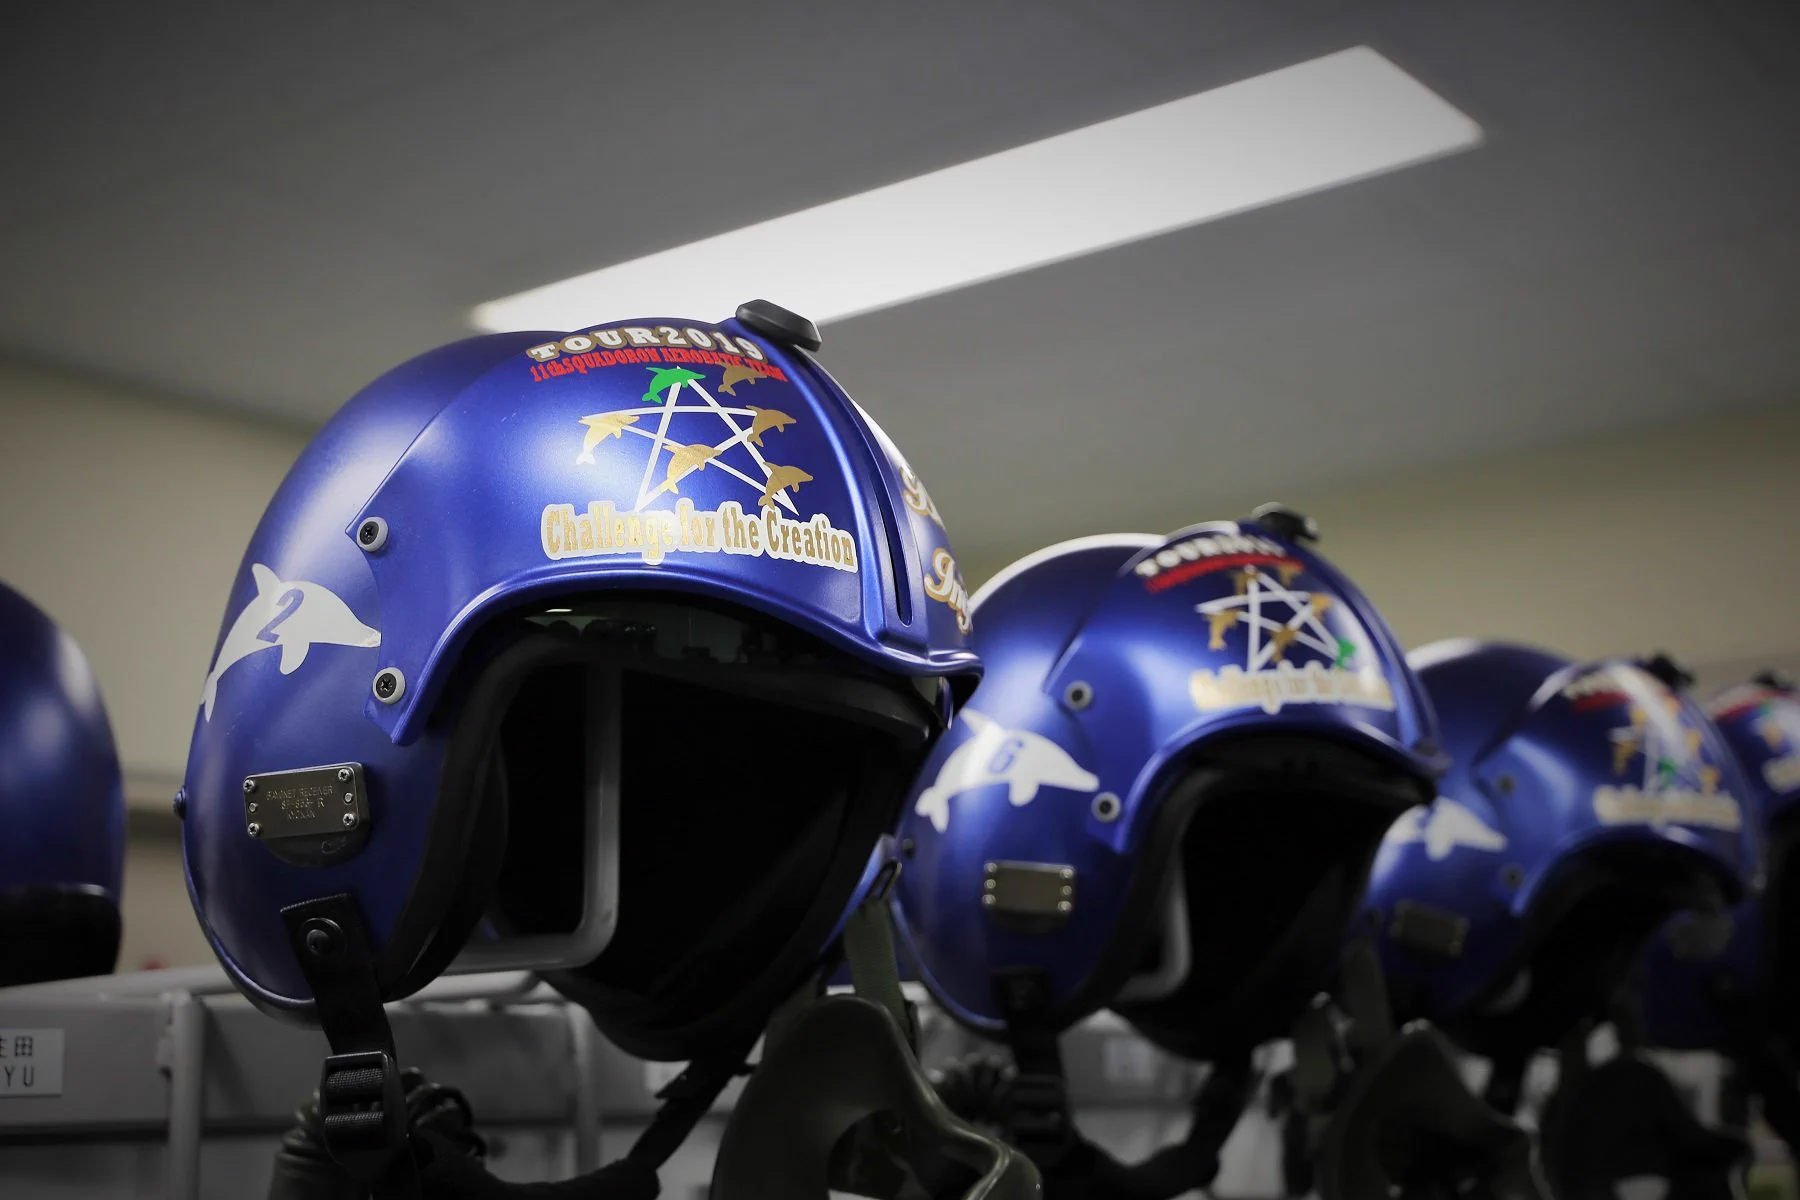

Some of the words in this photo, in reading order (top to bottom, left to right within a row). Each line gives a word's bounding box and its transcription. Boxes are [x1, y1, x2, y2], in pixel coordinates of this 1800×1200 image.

[527, 325, 766, 362] TOUR2019
[546, 504, 674, 559] Challenge
[680, 503, 716, 547] for
[722, 506, 761, 550] the
[765, 510, 855, 568] Creation
[255, 587, 305, 644] 2
[987, 737, 1025, 774] 6
